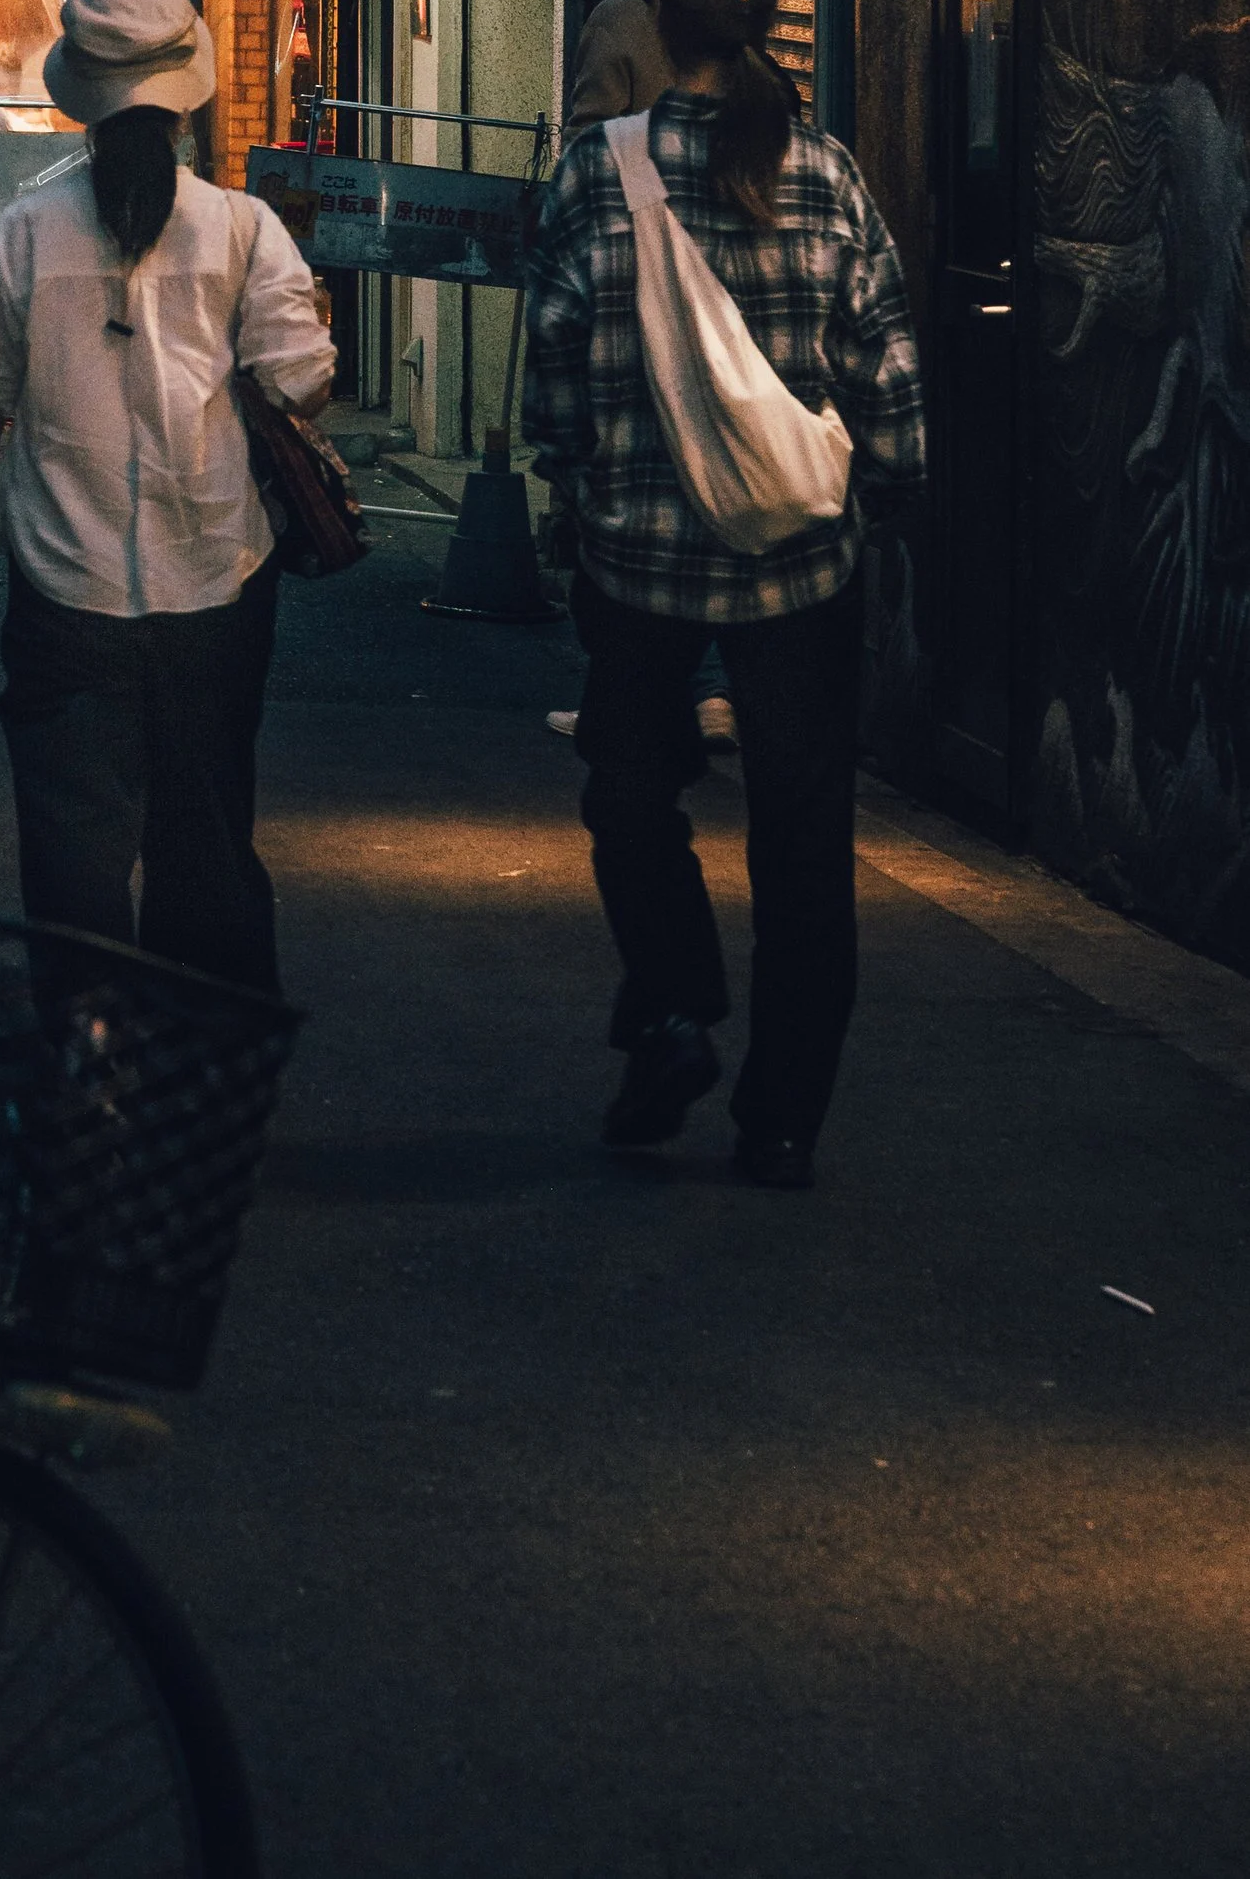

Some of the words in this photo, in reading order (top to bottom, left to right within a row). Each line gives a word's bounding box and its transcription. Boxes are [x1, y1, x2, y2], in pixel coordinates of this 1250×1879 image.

[321, 175, 358, 190] ここは
[320, 192, 381, 217] 自転車
